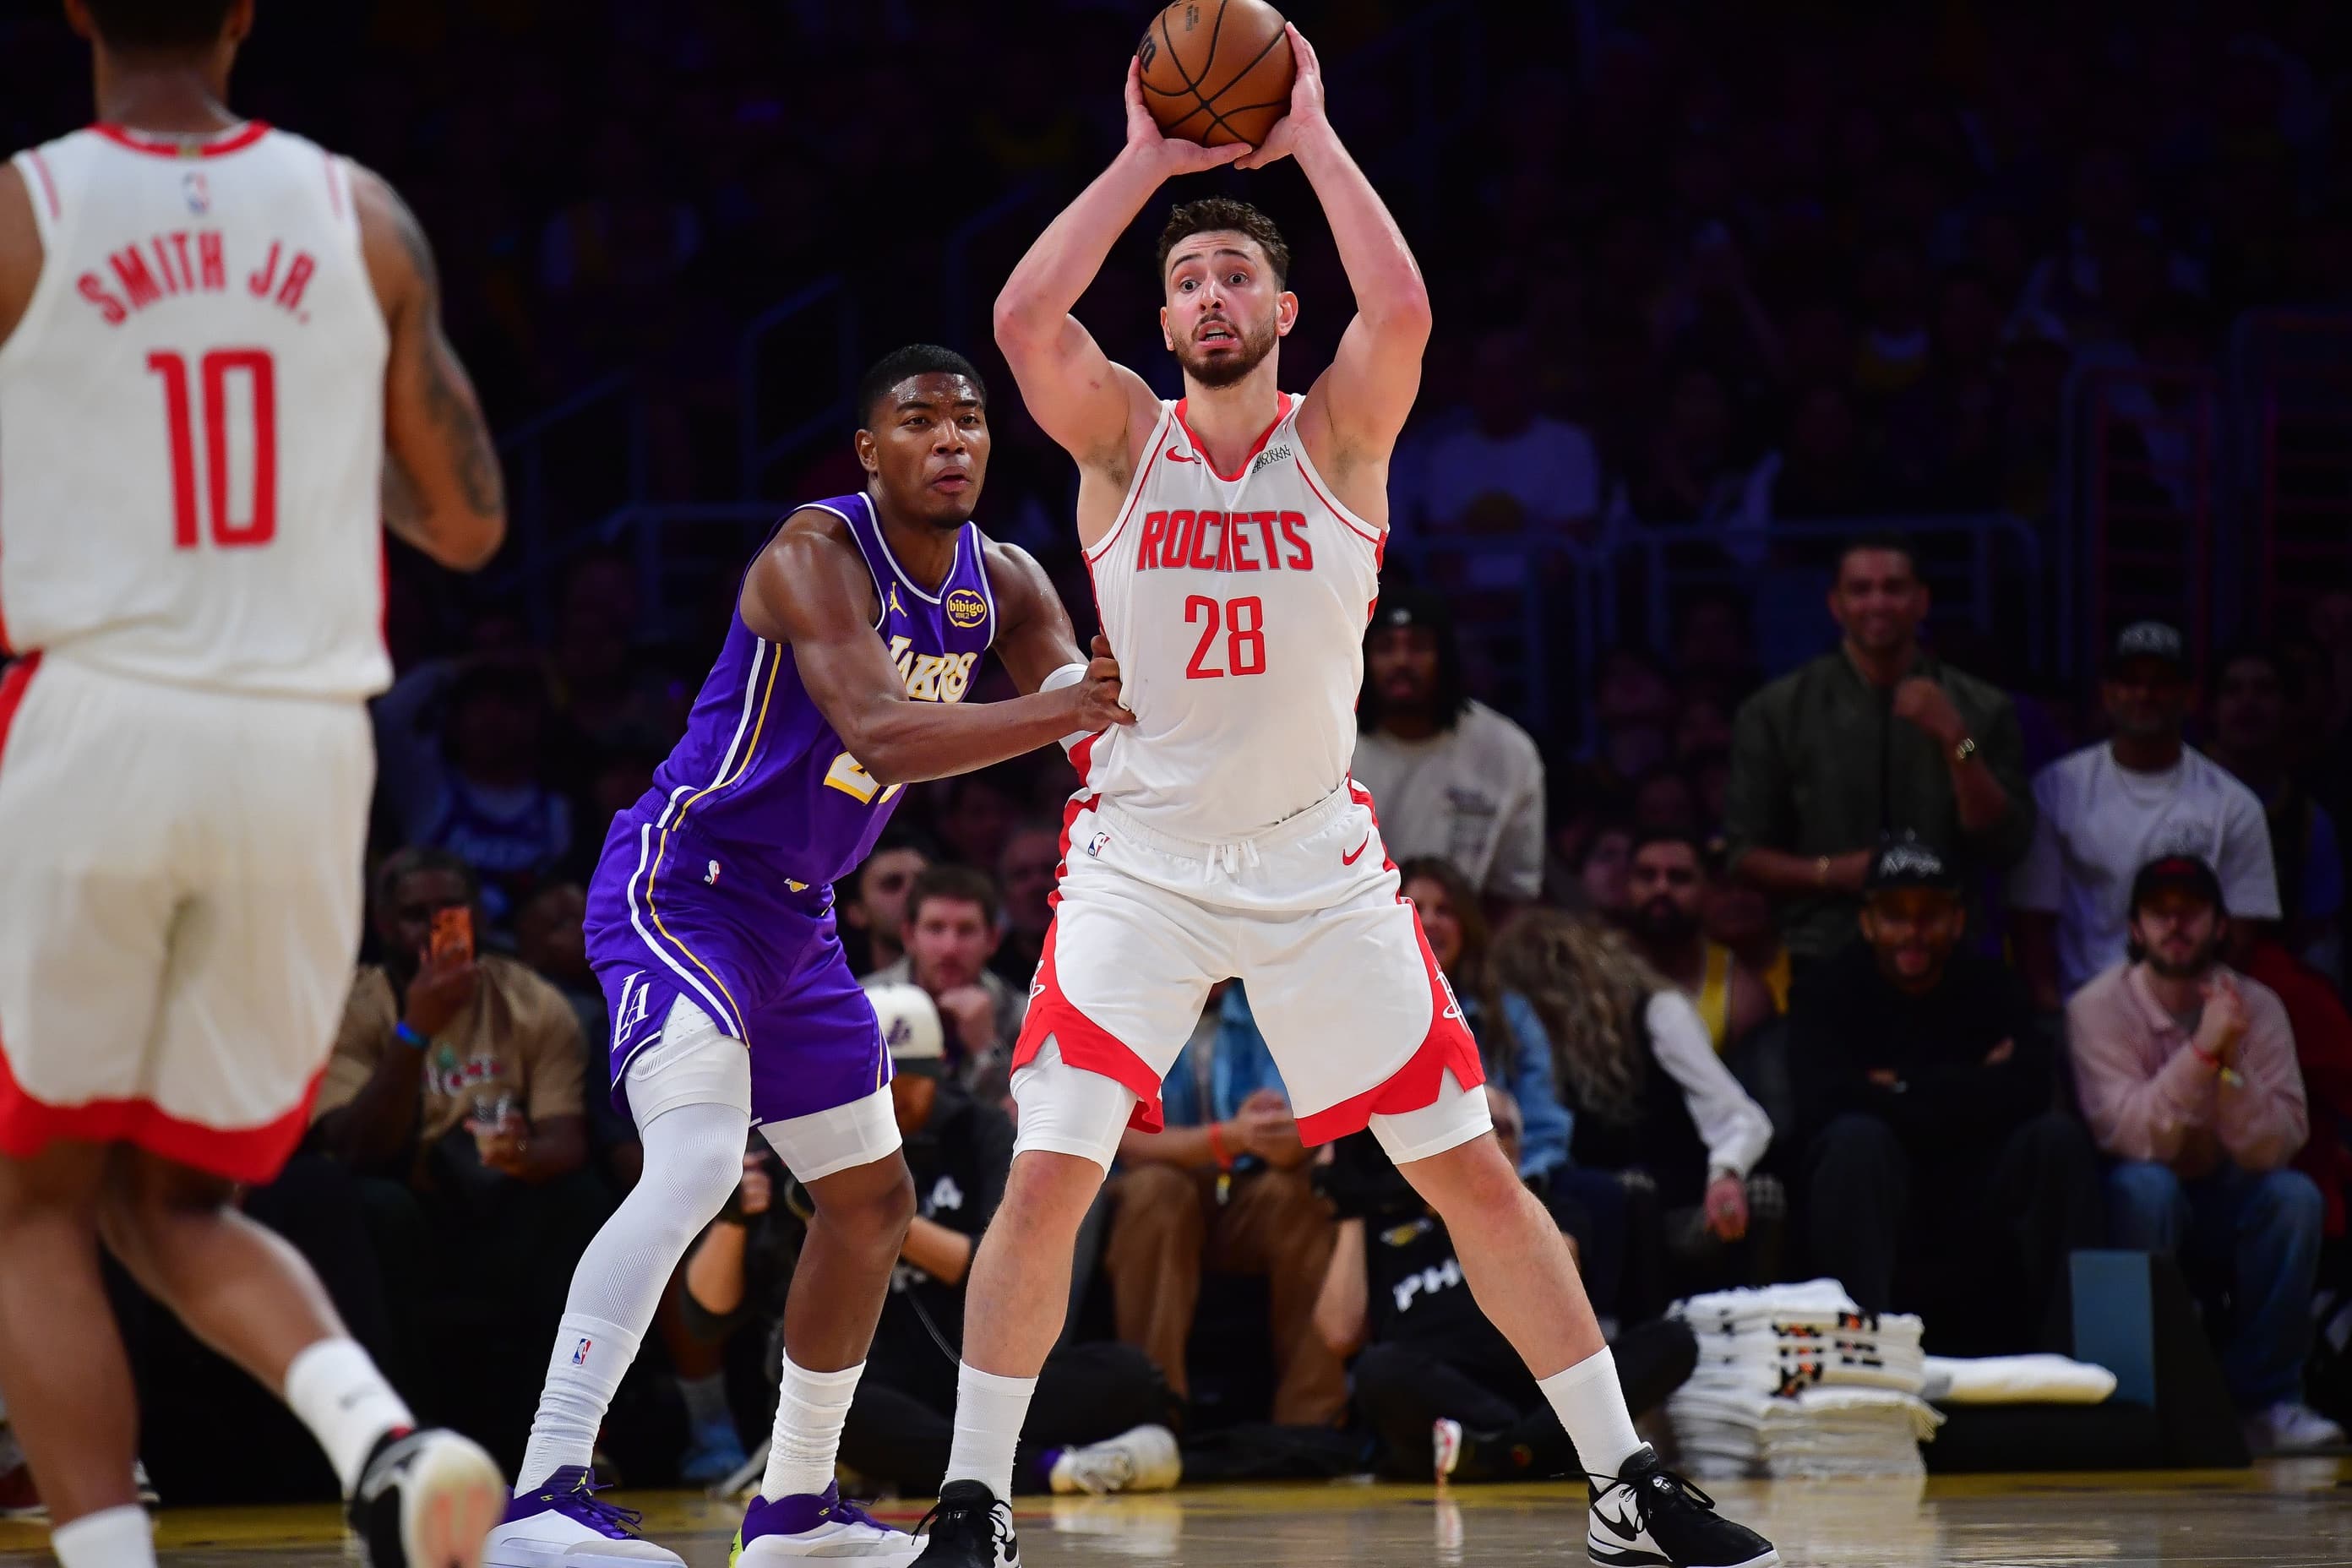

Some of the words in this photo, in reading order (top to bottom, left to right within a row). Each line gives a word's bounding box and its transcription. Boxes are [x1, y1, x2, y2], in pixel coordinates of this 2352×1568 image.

[76, 229, 229, 326] SMITH
[248, 240, 318, 324] JR.
[145, 346, 278, 548] 10
[949, 599, 984, 617] bibigo
[1184, 594, 1267, 680] 28
[612, 969, 651, 1054] LA
